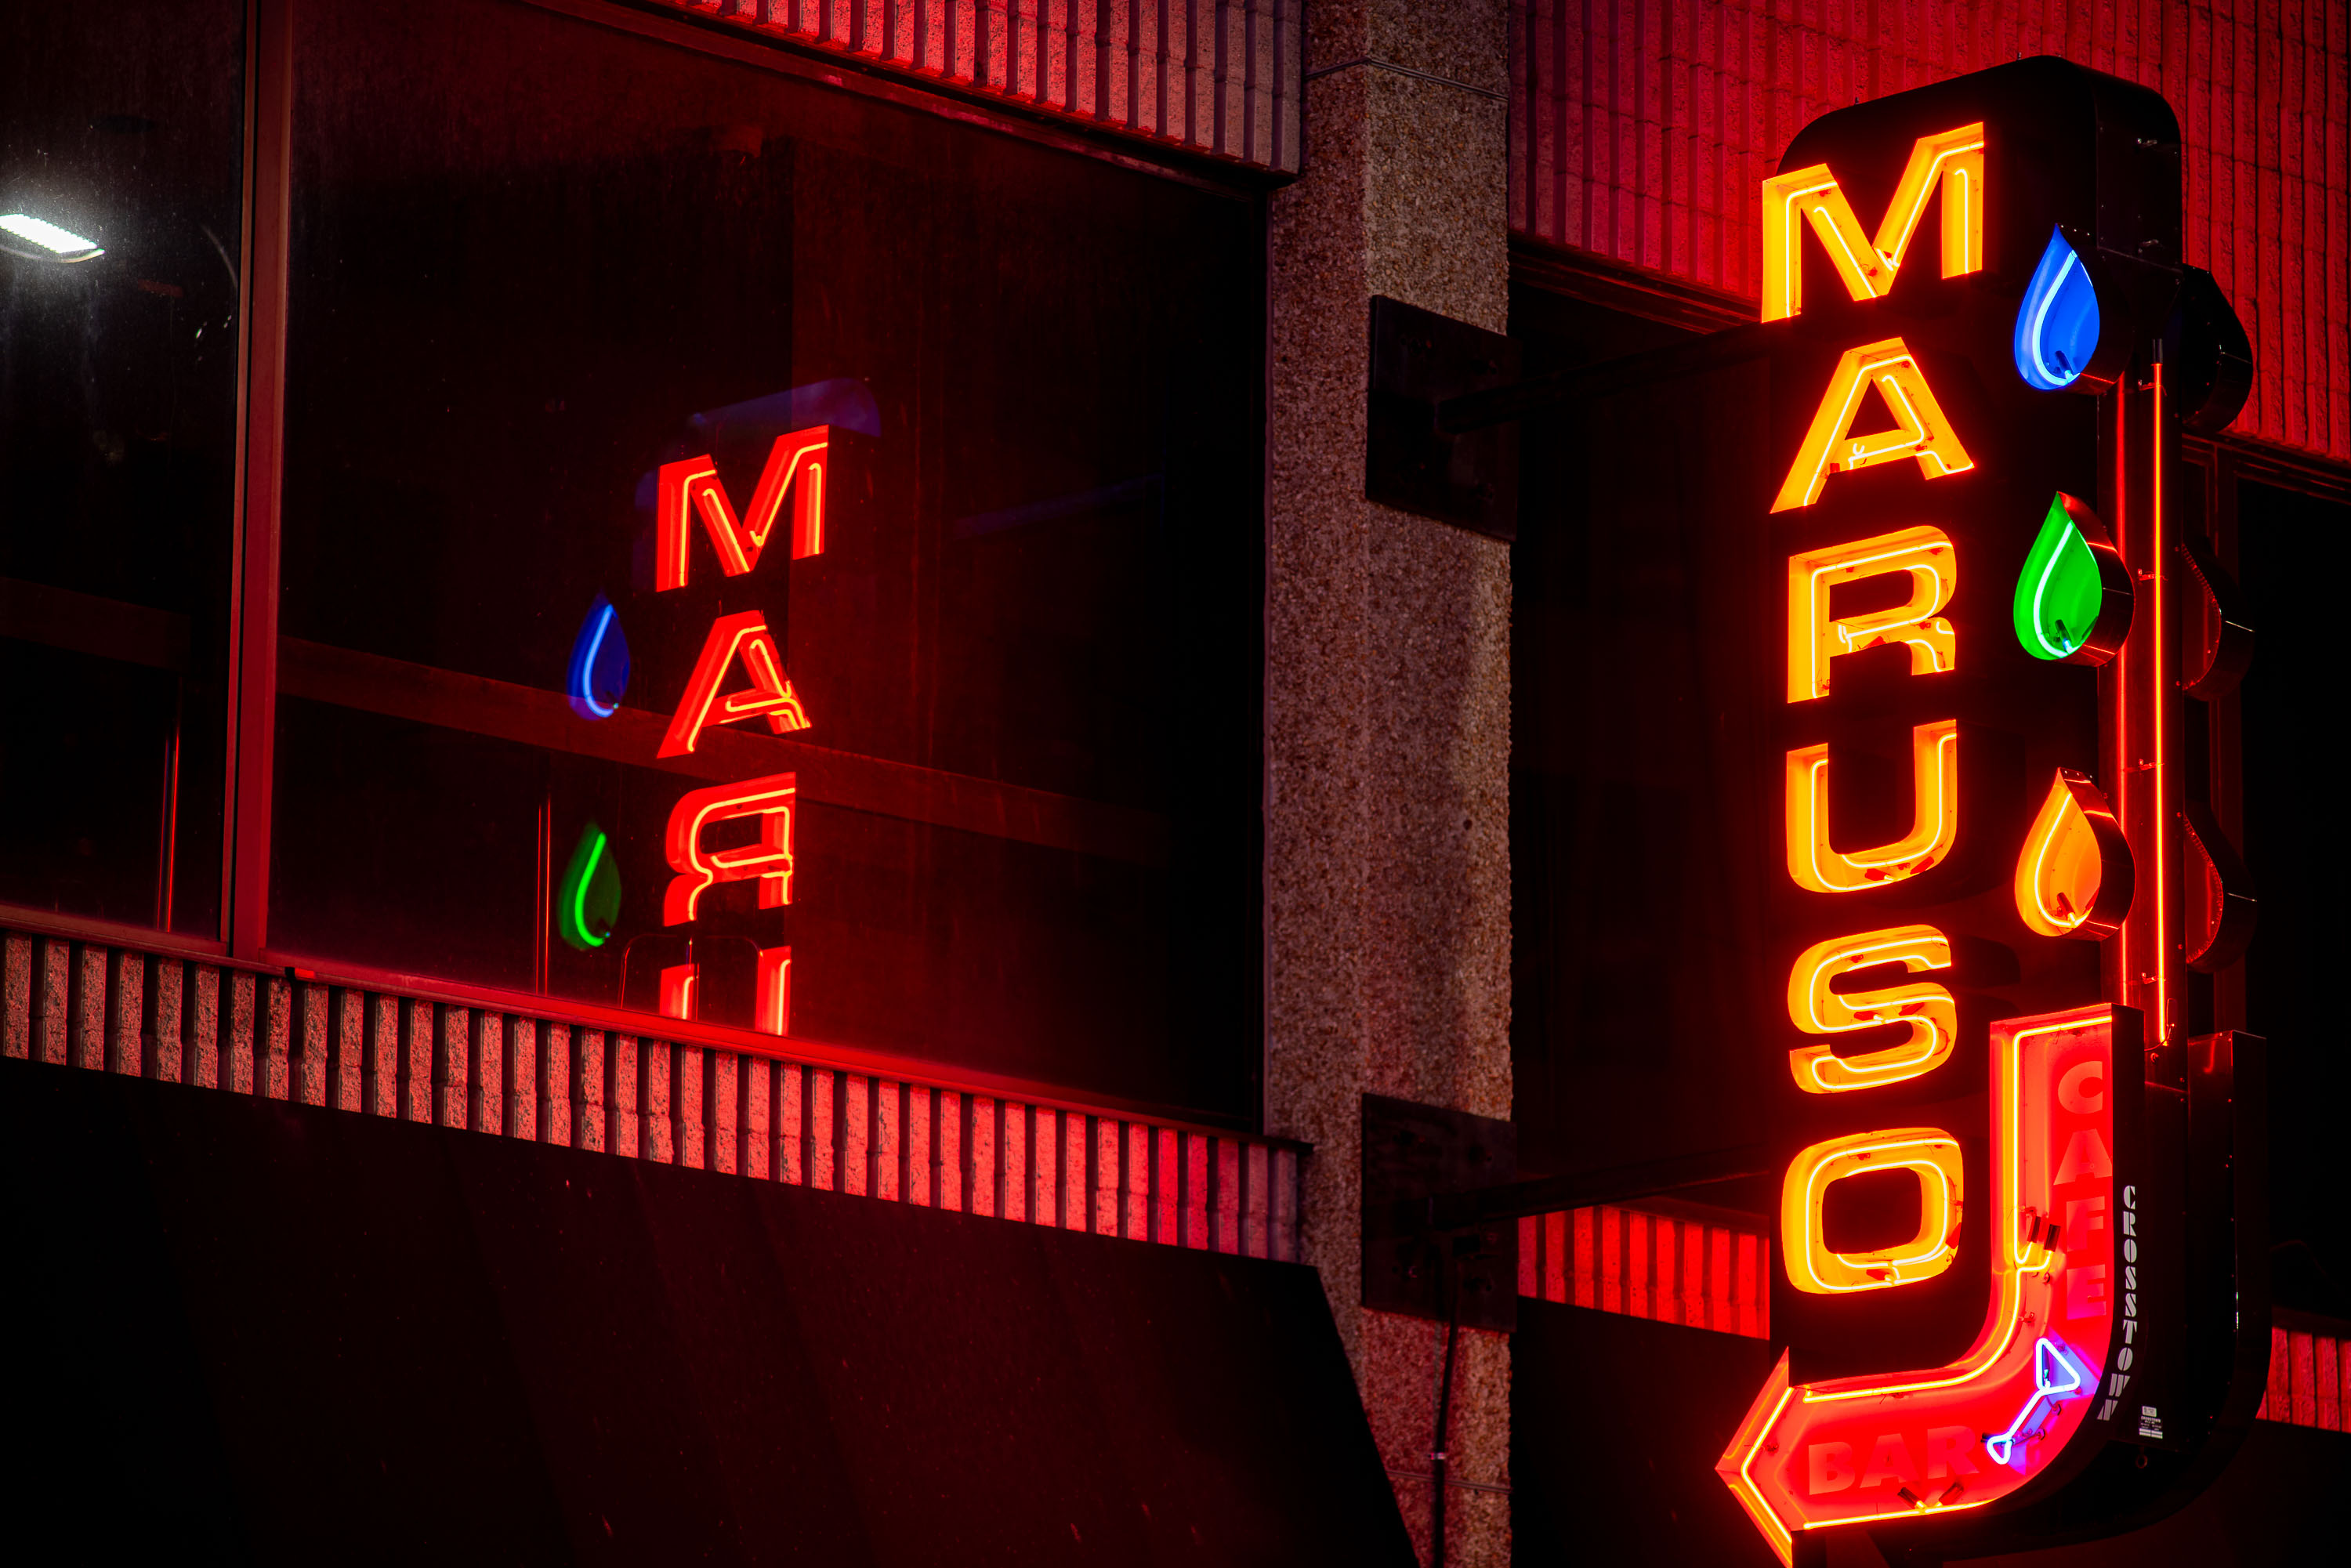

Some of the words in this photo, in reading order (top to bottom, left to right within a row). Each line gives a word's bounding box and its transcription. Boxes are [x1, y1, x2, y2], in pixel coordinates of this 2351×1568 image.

[1761, 121, 1984, 1295] MARUSO
[2053, 1060, 2113, 1320] CAFE
[2096, 1185, 2138, 1421] CROSSTOWN
[1809, 1425, 1980, 1495] BAR
